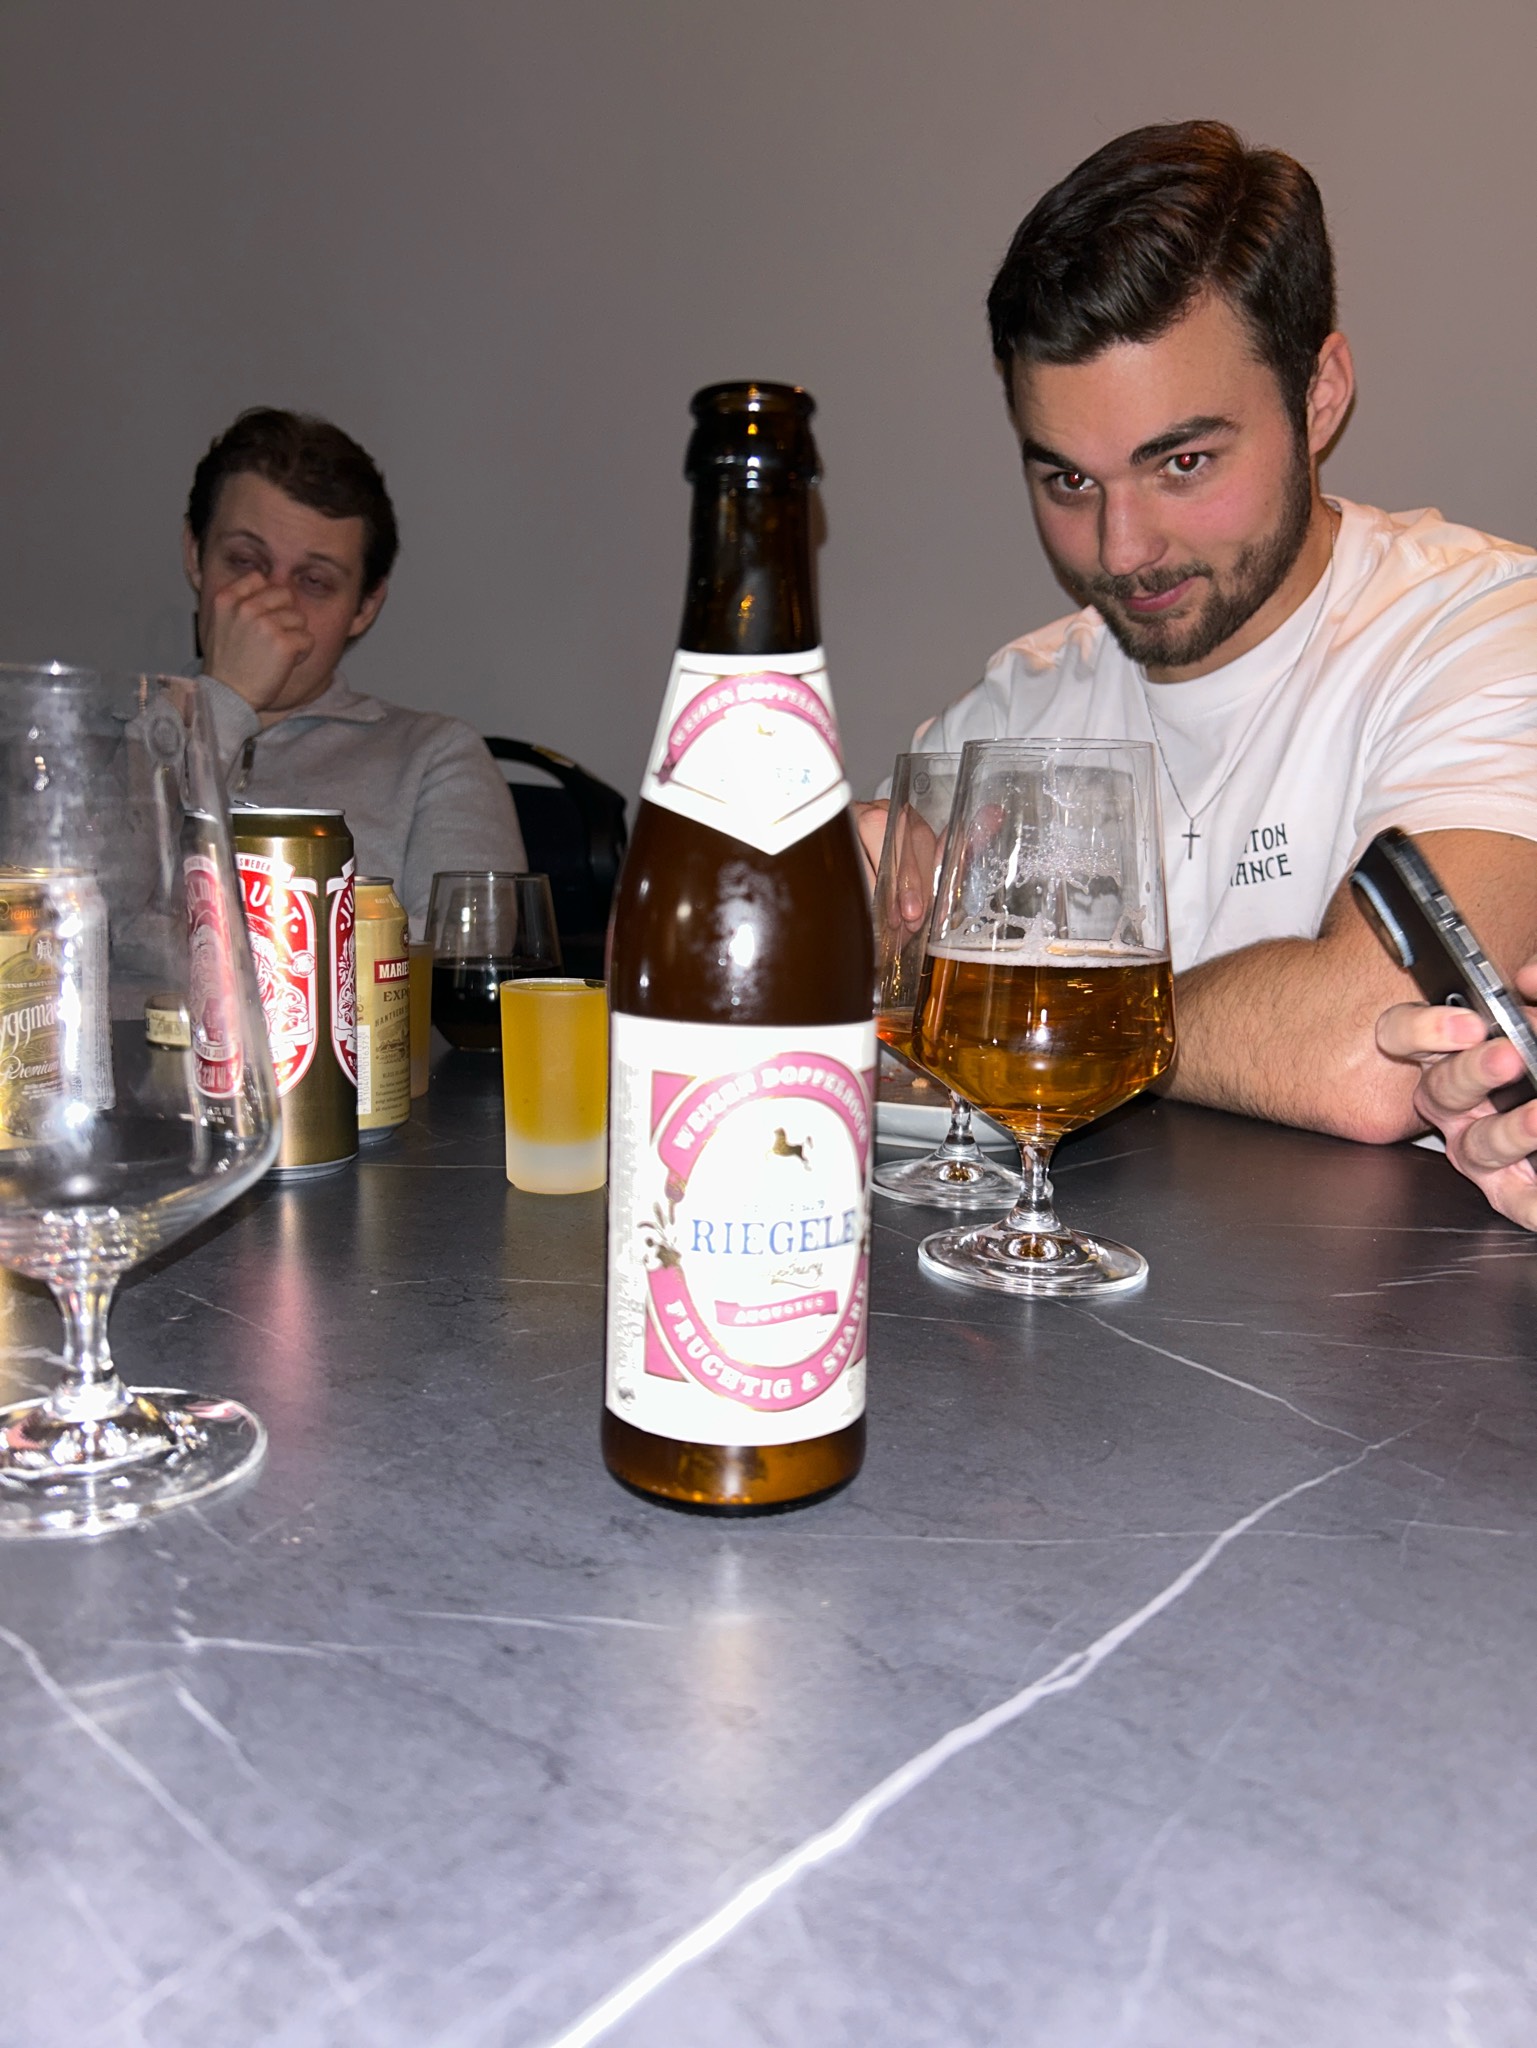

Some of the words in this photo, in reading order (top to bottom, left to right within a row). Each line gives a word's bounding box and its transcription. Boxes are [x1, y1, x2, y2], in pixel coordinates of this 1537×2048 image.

[1243, 823, 1289, 854] TON
[1230, 853, 1292, 887] ANCE
[378, 960, 409, 979] MARIE
[690, 1206, 857, 1256] RIEGELE
[664, 1299, 793, 1400] FRUCHTIG
